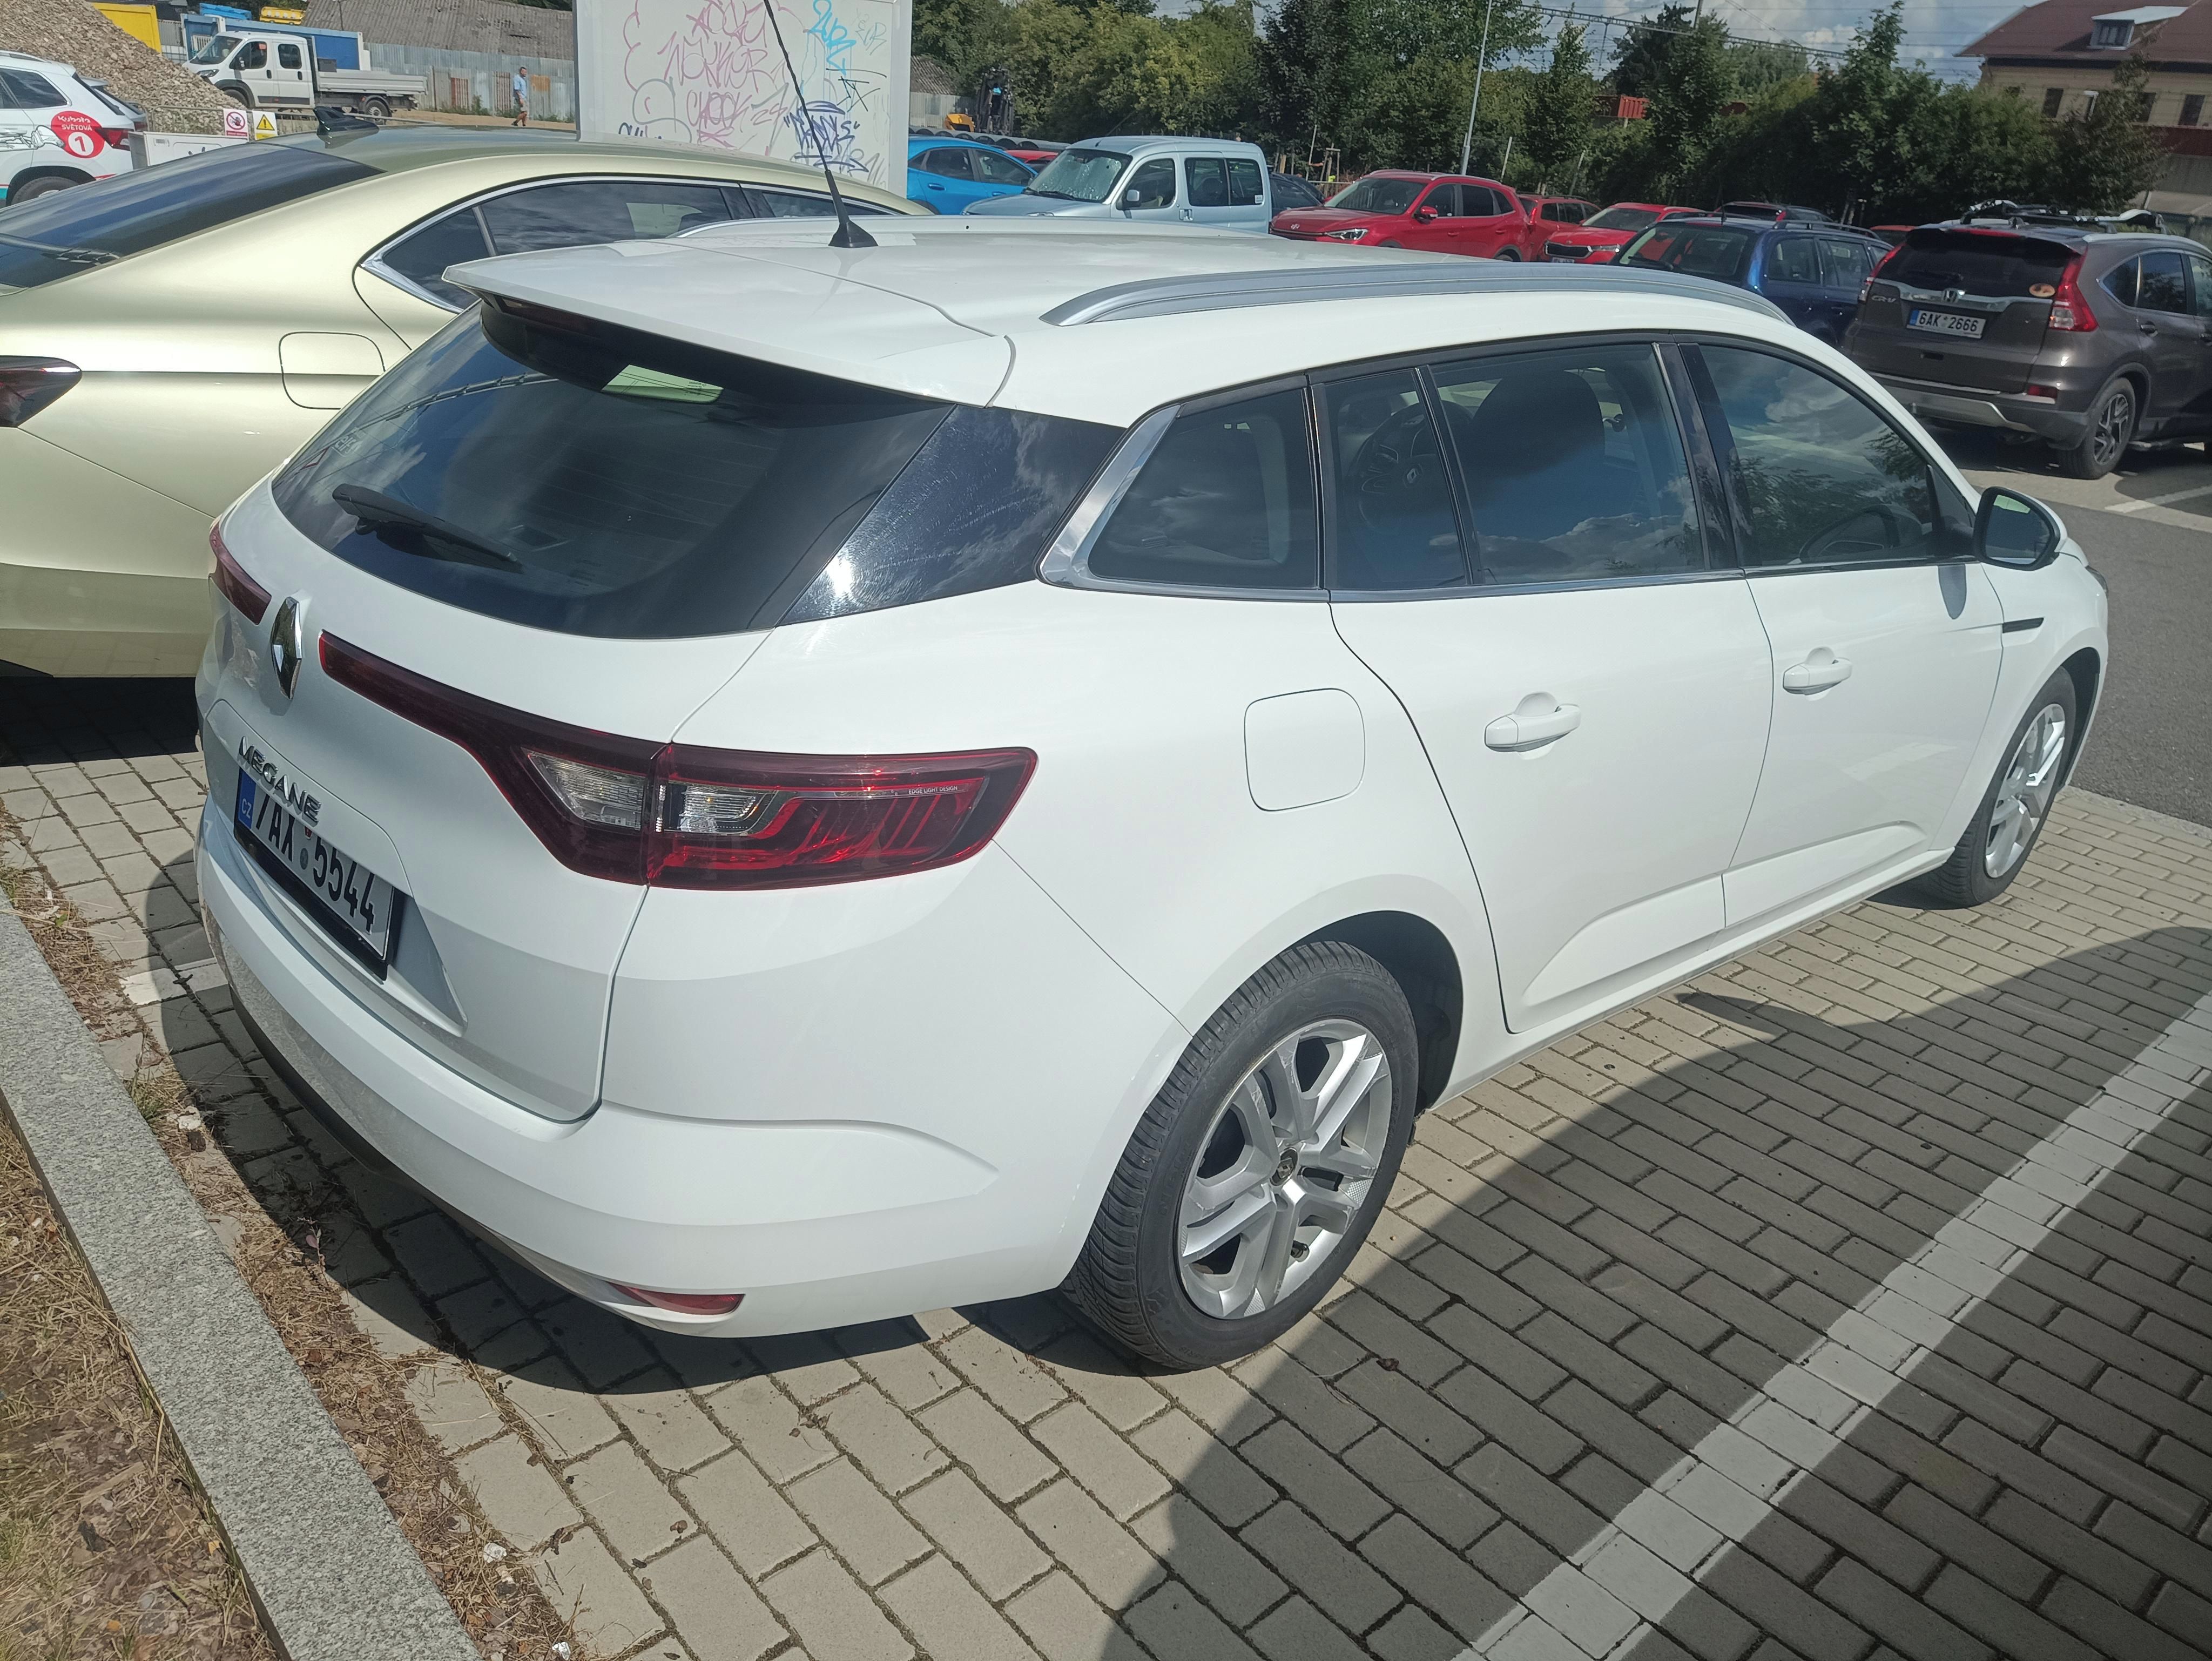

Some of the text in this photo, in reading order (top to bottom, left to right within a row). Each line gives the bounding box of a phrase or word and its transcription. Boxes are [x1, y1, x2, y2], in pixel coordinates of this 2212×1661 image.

[75, 136, 86, 152] 1
[1919, 313, 1941, 327] 6AK
[1947, 317, 1979, 332] 2666
[239, 735, 322, 822] MEGANE
[241, 798, 252, 820] CZ
